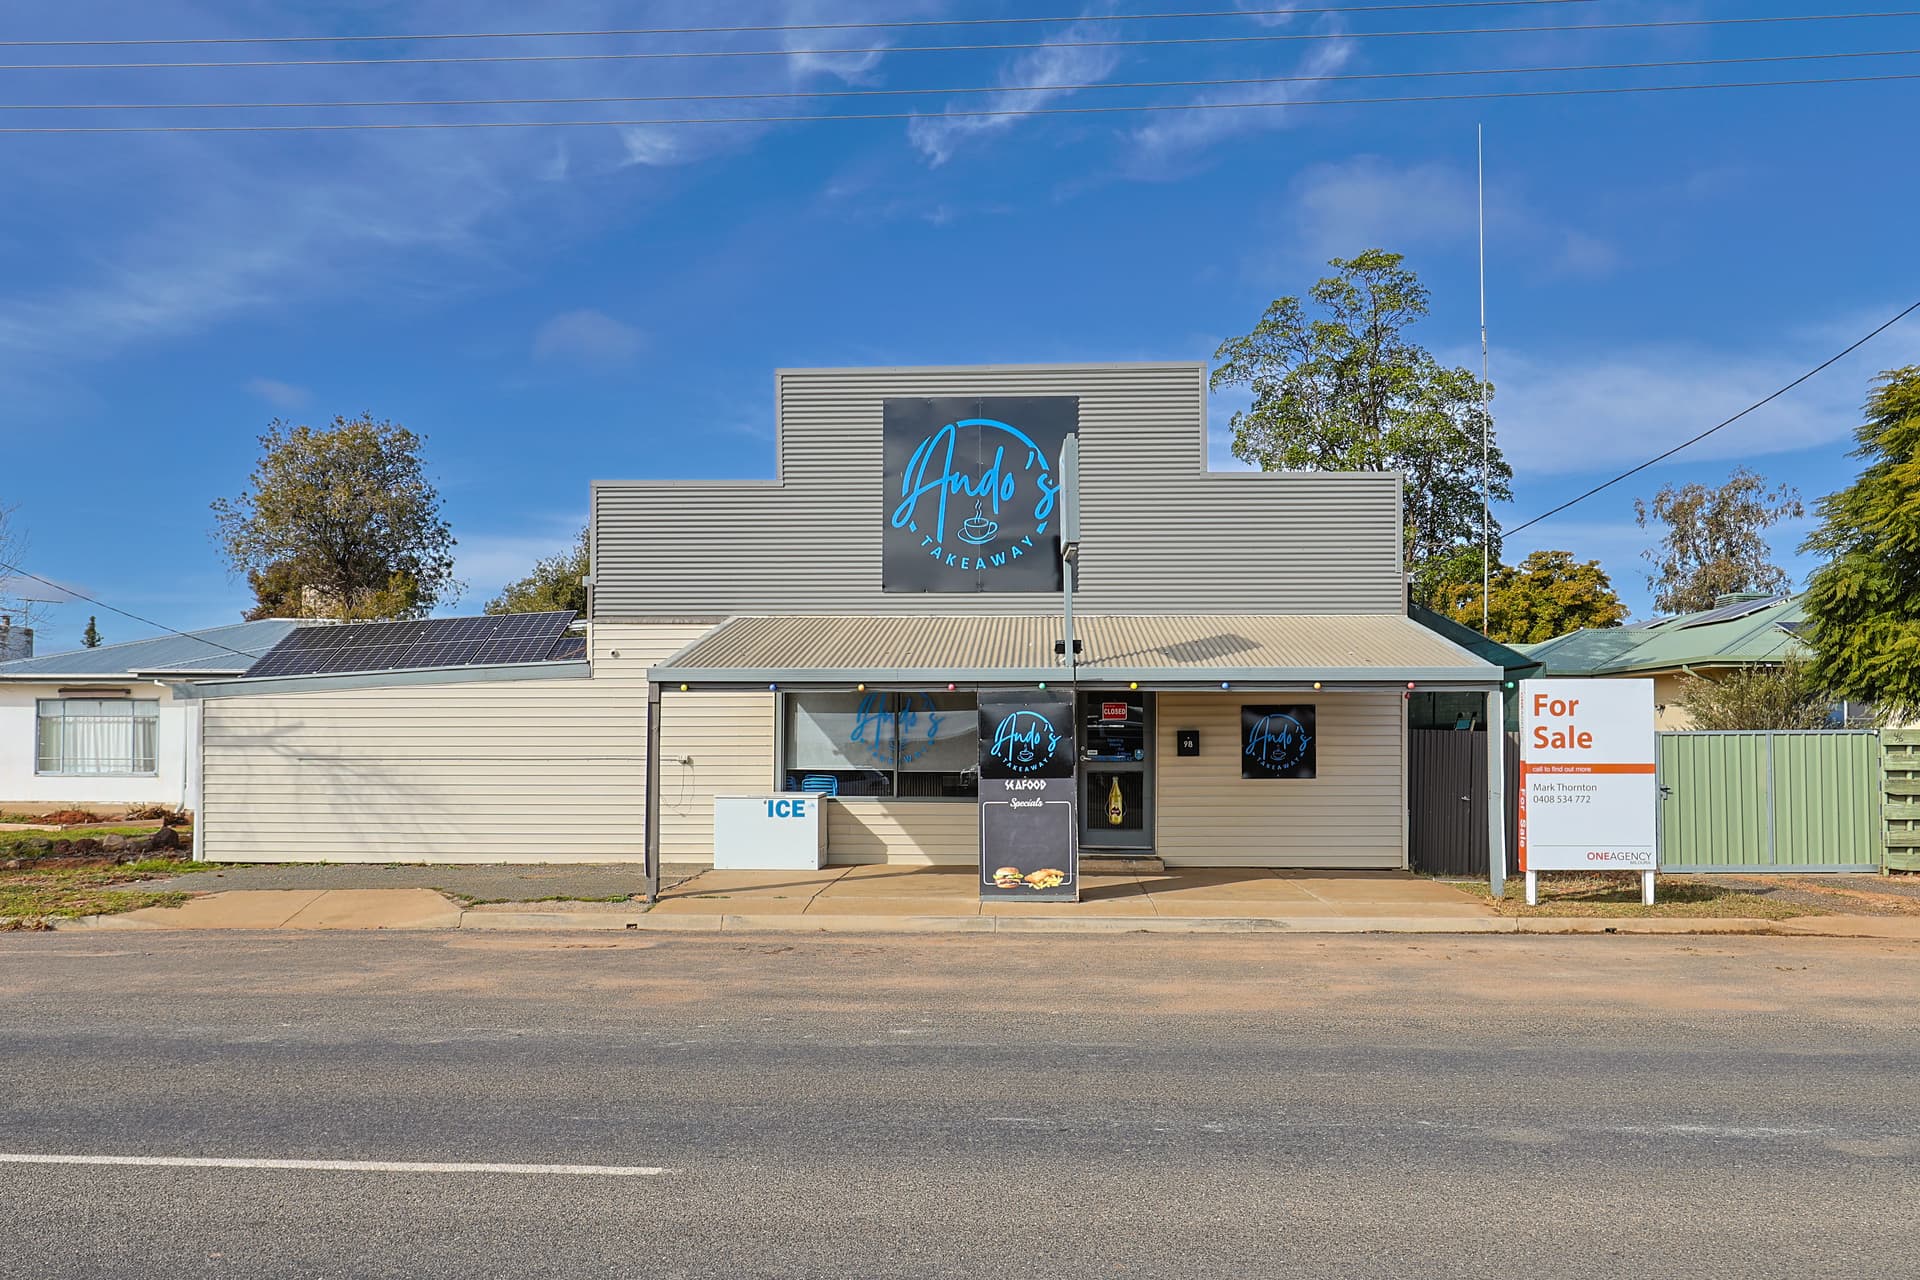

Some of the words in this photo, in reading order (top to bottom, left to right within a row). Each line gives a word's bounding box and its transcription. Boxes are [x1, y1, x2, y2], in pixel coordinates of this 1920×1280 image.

[891, 424, 1061, 544] Ando's
[921, 535, 1033, 570] TAKEAWAY
[1534, 694, 1579, 717] For
[991, 713, 1062, 762] Ando's
[1183, 740, 1193, 748] 98
[1245, 716, 1312, 761] Ando's
[1534, 725, 1593, 749] Sale
[1002, 757, 1048, 772] TAKEAWAY
[1004, 780, 1047, 790] SEAFOOD
[1533, 783, 1555, 791] Mark
[1557, 783, 1597, 791] Thornton
[1009, 797, 1044, 810] Specials
[1533, 795, 1555, 803] 0408
[1557, 795, 1573, 803] 534
[1575, 795, 1591, 803] 772
[768, 800, 806, 818] ICE
[1587, 851, 1652, 861] ONEAGENCY
